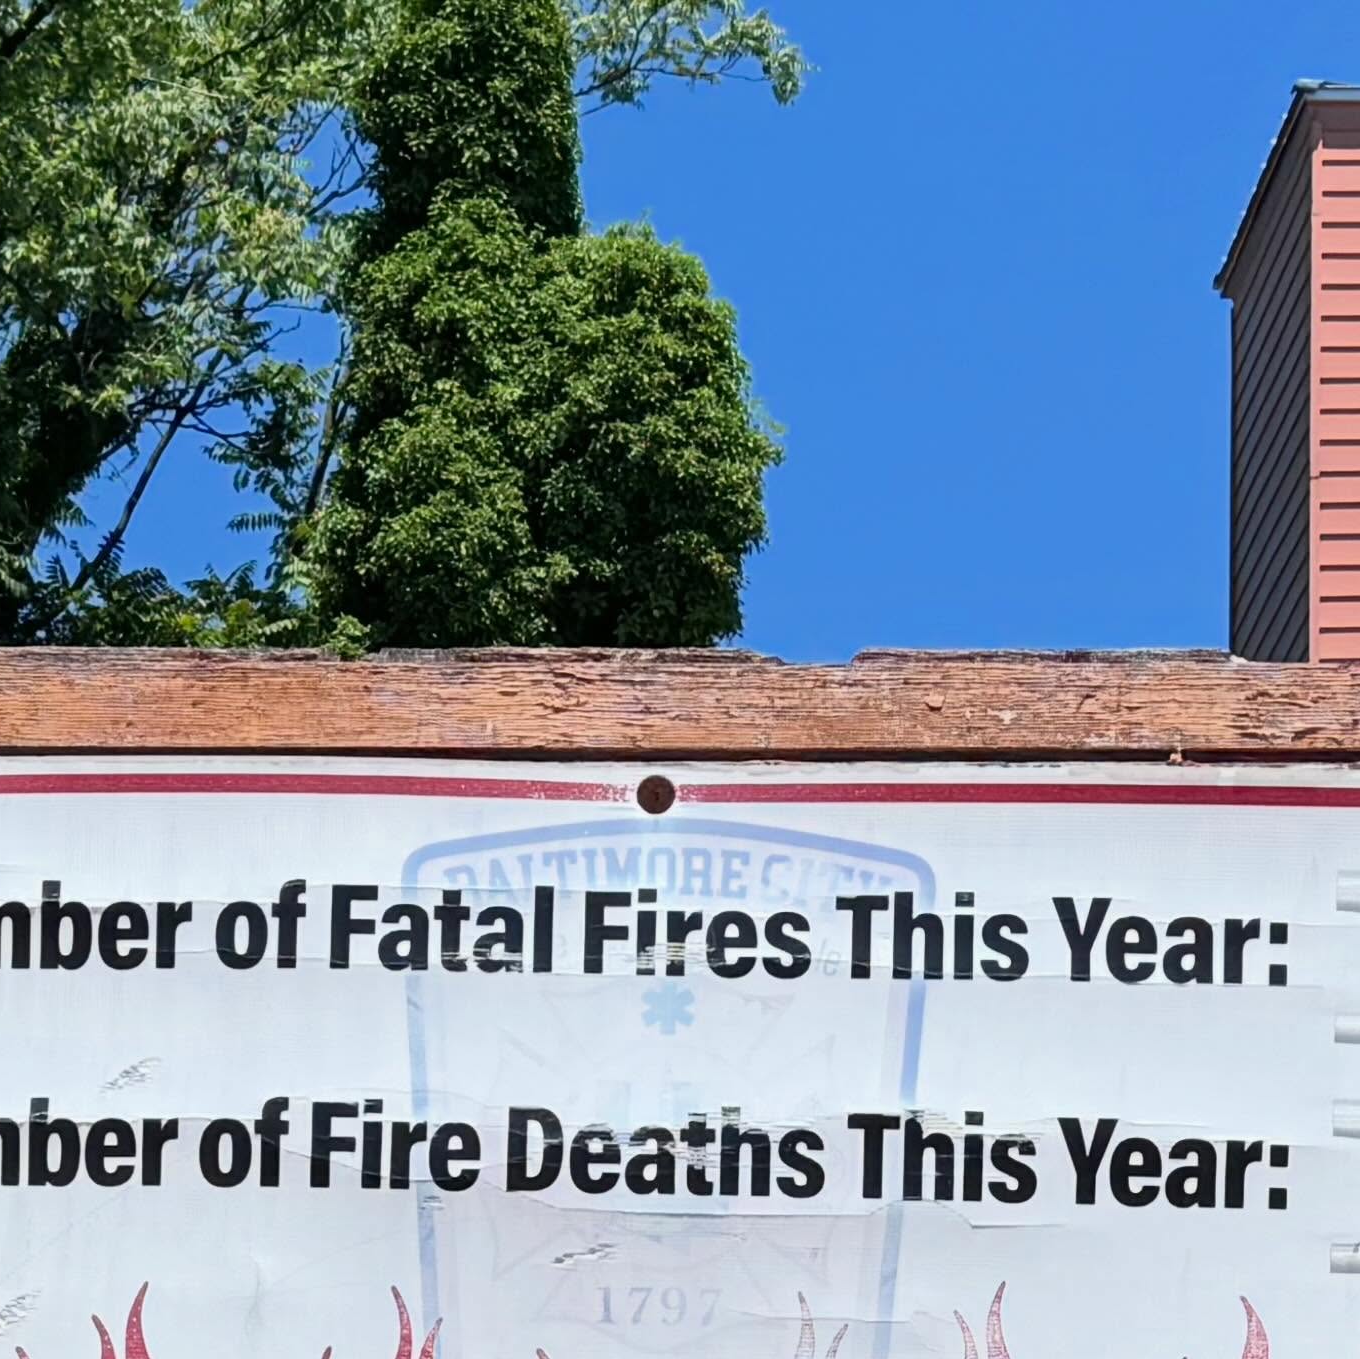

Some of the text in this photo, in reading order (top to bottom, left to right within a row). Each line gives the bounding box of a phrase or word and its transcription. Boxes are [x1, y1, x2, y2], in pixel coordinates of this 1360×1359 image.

[215, 878, 307, 970] of
[329, 884, 554, 974] Fatal
[583, 888, 811, 979] Fires
[835, 891, 1030, 982] This
[1052, 896, 1289, 987] Year:
[198, 1095, 290, 1188] of
[309, 1098, 482, 1192] Fire
[505, 1105, 826, 1199] Deaths
[847, 1109, 1038, 1204] This
[1057, 1116, 1289, 1210] Year:
[597, 1285, 724, 1327] 1797
